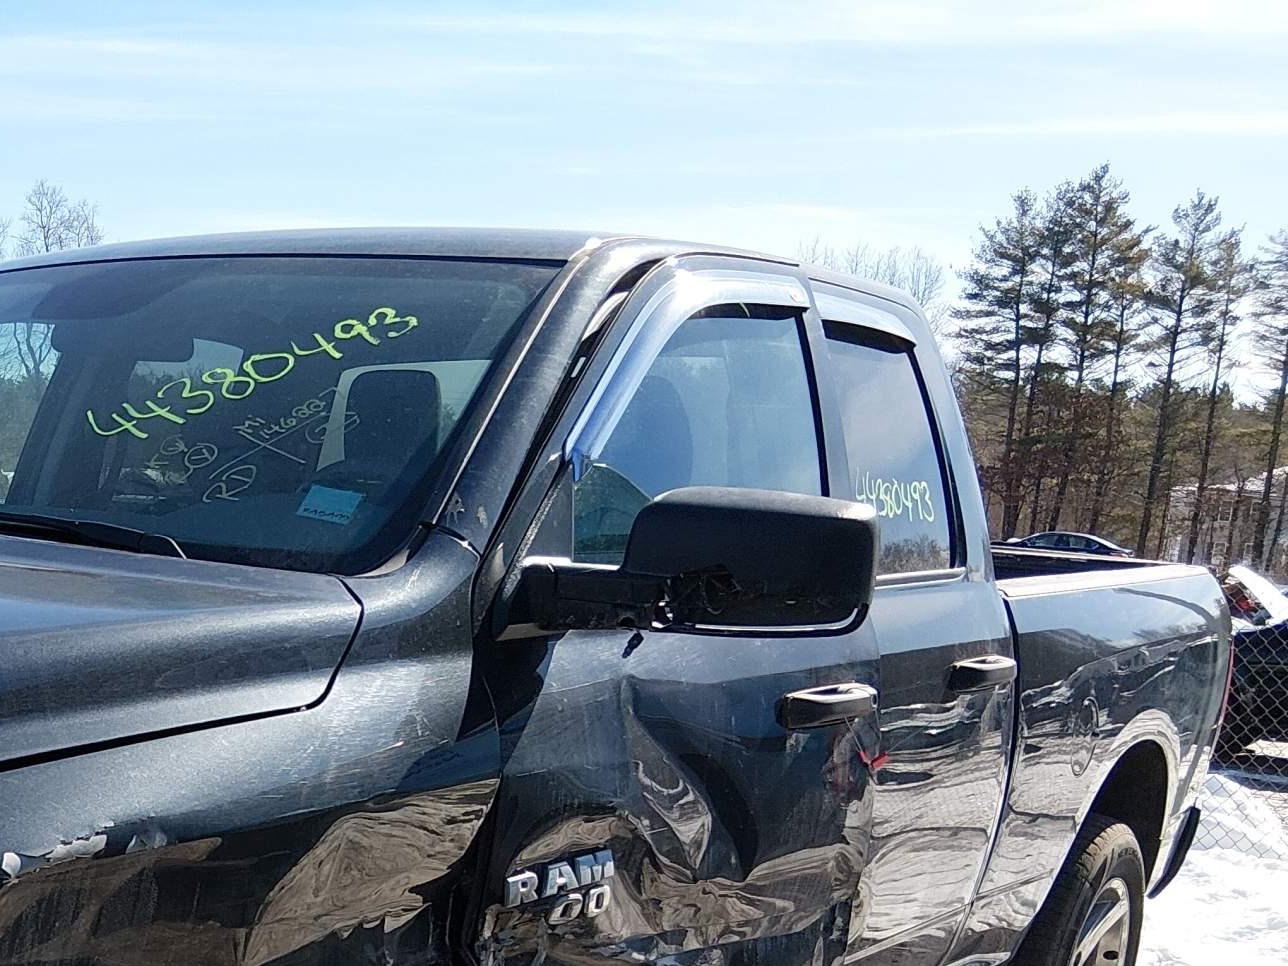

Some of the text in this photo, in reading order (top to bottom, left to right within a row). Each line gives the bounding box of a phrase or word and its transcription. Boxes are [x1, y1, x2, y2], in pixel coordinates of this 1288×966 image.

[86, 305, 419, 441] 44380493
[855, 465, 935, 522] 44380493
[505, 849, 615, 907] RAM
